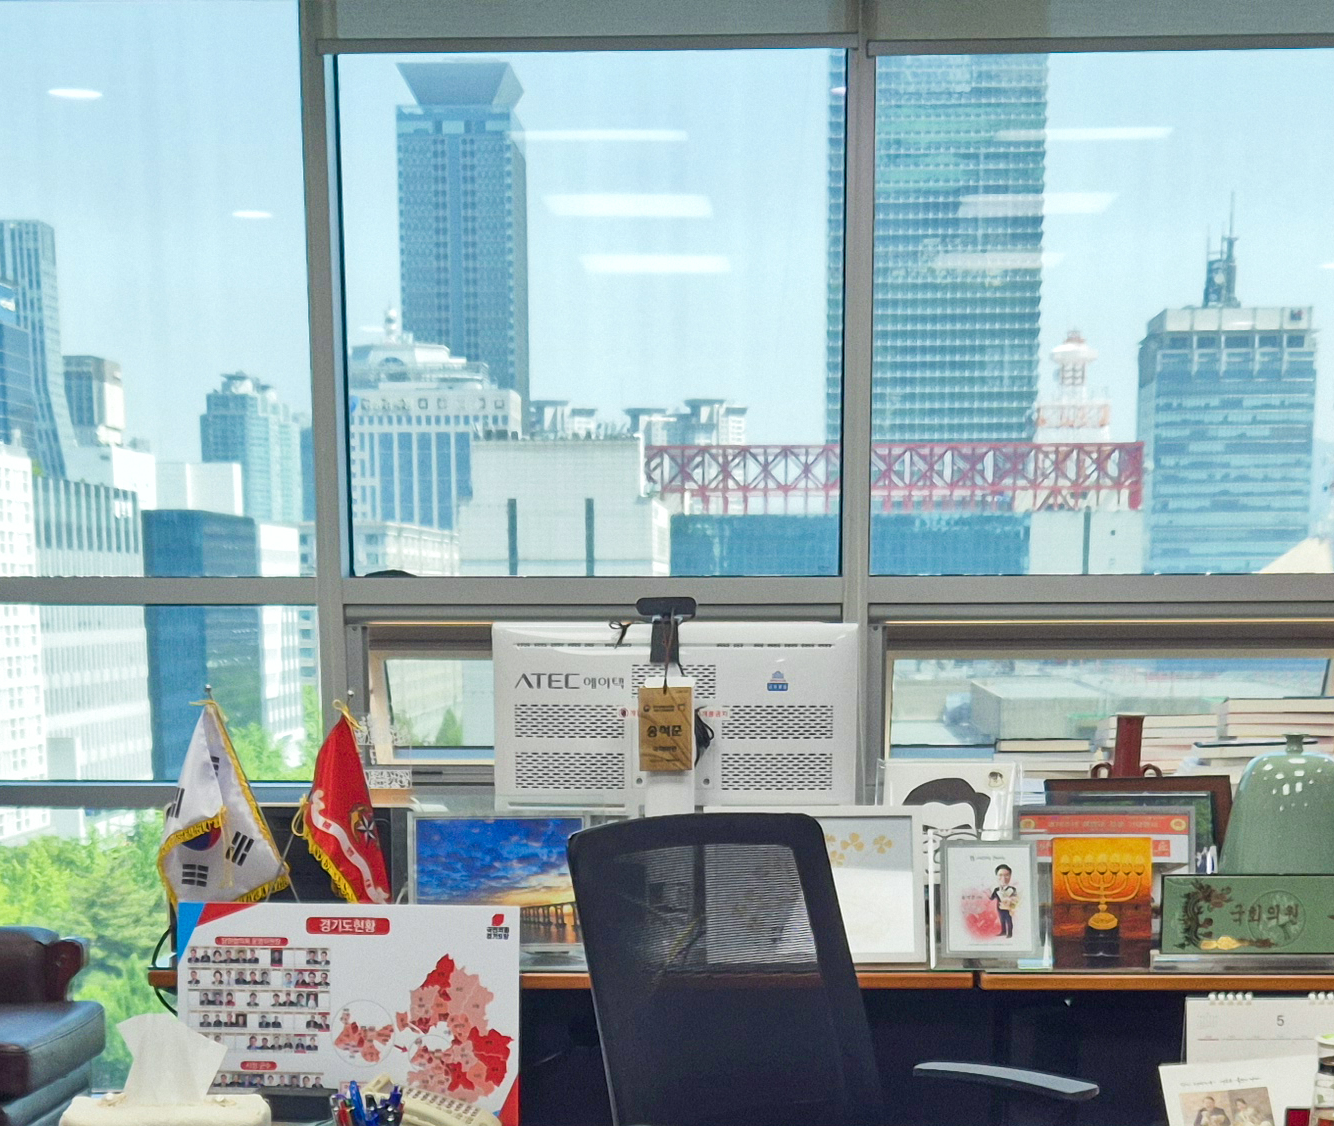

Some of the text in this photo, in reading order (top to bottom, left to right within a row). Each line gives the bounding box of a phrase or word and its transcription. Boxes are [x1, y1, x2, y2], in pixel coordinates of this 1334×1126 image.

[514, 673, 580, 690] ATEC
[1229, 902, 1300, 926] 국회의원
[319, 918, 377, 933] 경기도현황
[1275, 1014, 1286, 1028] 5
